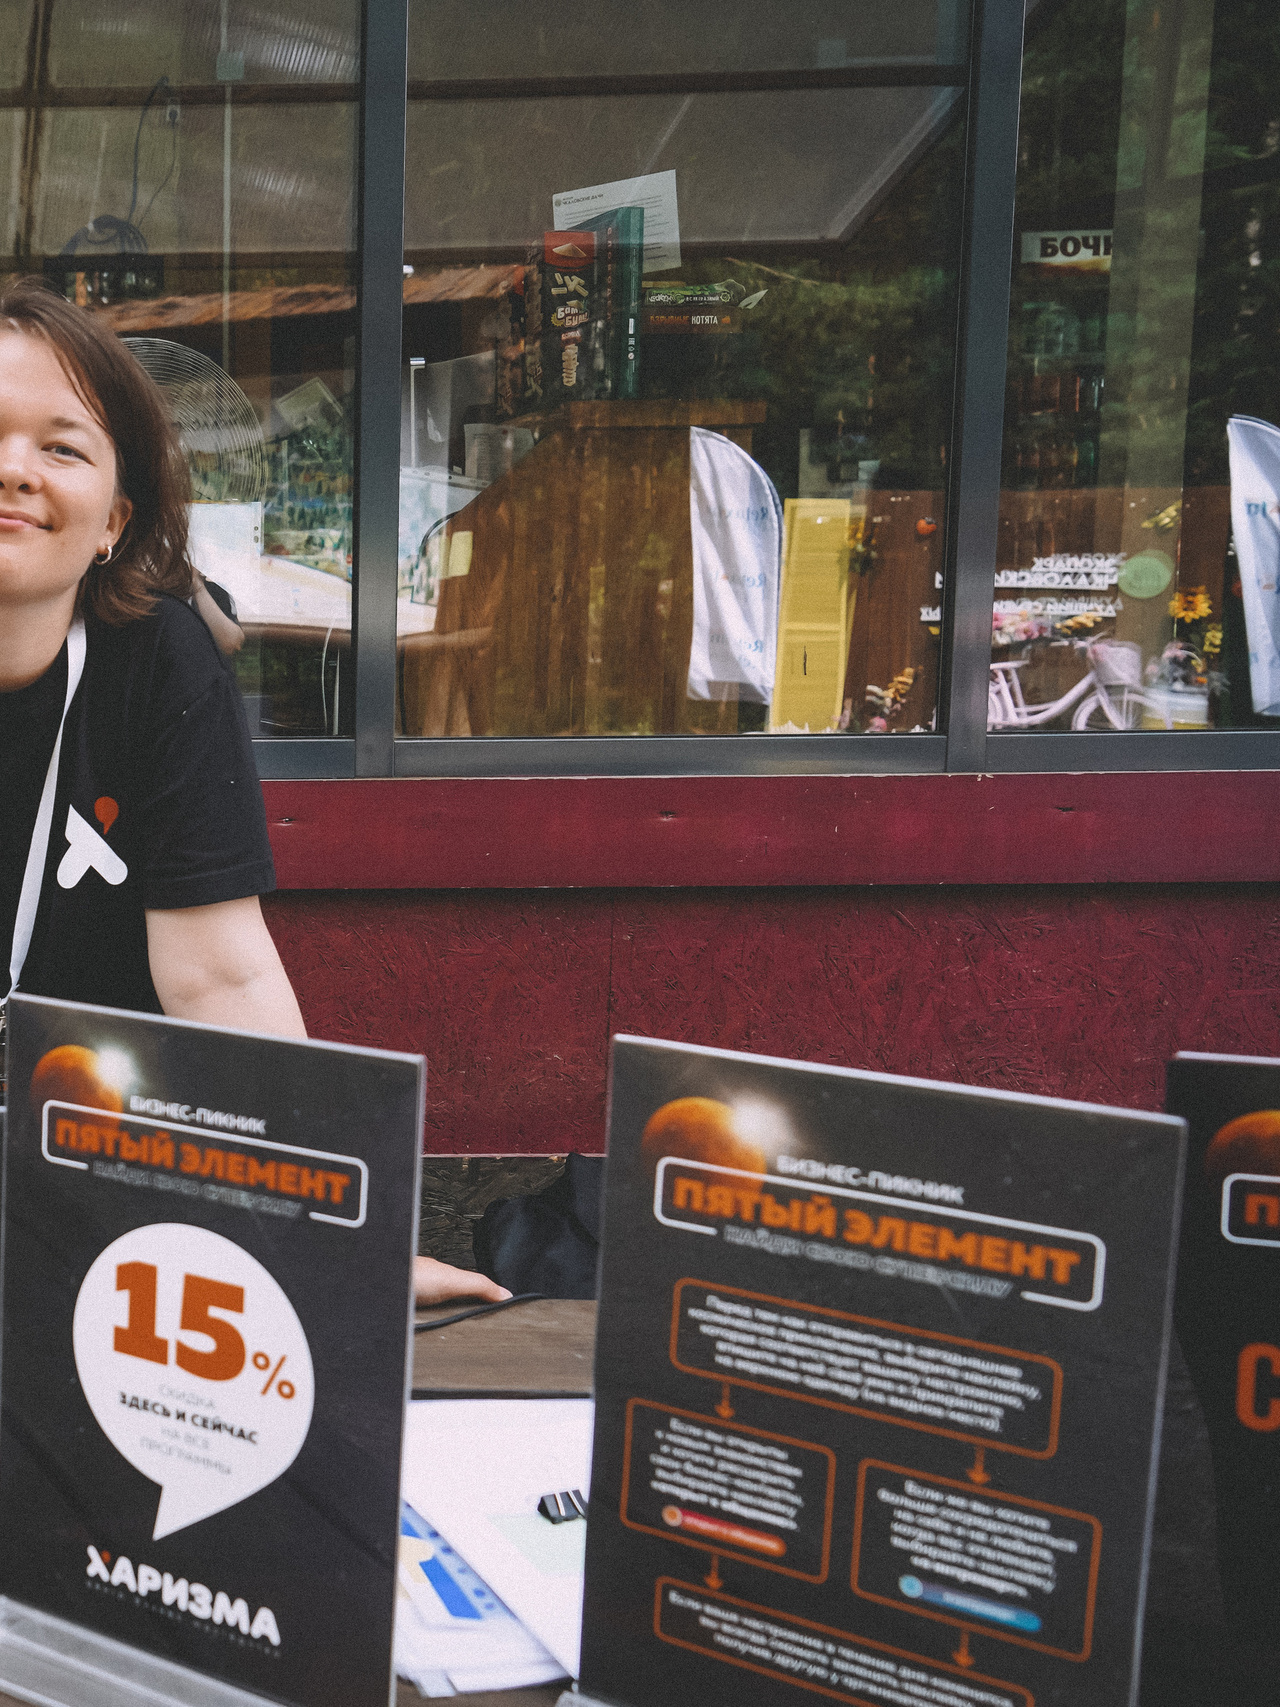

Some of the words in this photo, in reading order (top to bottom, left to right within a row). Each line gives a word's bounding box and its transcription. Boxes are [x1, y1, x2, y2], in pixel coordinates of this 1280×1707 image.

[691, 315, 718, 325] КОТЯТА
[129, 1094, 267, 1136] БИЗНЕС-ПИКНИК
[54, 1117, 175, 1170] ПЯТЫЙ
[179, 1142, 351, 1204] ЭЛЕМЕНТ
[776, 1154, 965, 1206] БИЗНЕС-ПИКНИК
[673, 1175, 838, 1239] ПЯТЫЙ
[842, 1208, 1081, 1286] ЭЛЕМЕНТ
[113, 1259, 296, 1400] 15%
[119, 1390, 170, 1418] ЗДЕСЬ
[176, 1409, 186, 1422] И
[191, 1413, 258, 1445] СЕЙЧАС
[86, 1544, 281, 1646] ХАРИЗМА
